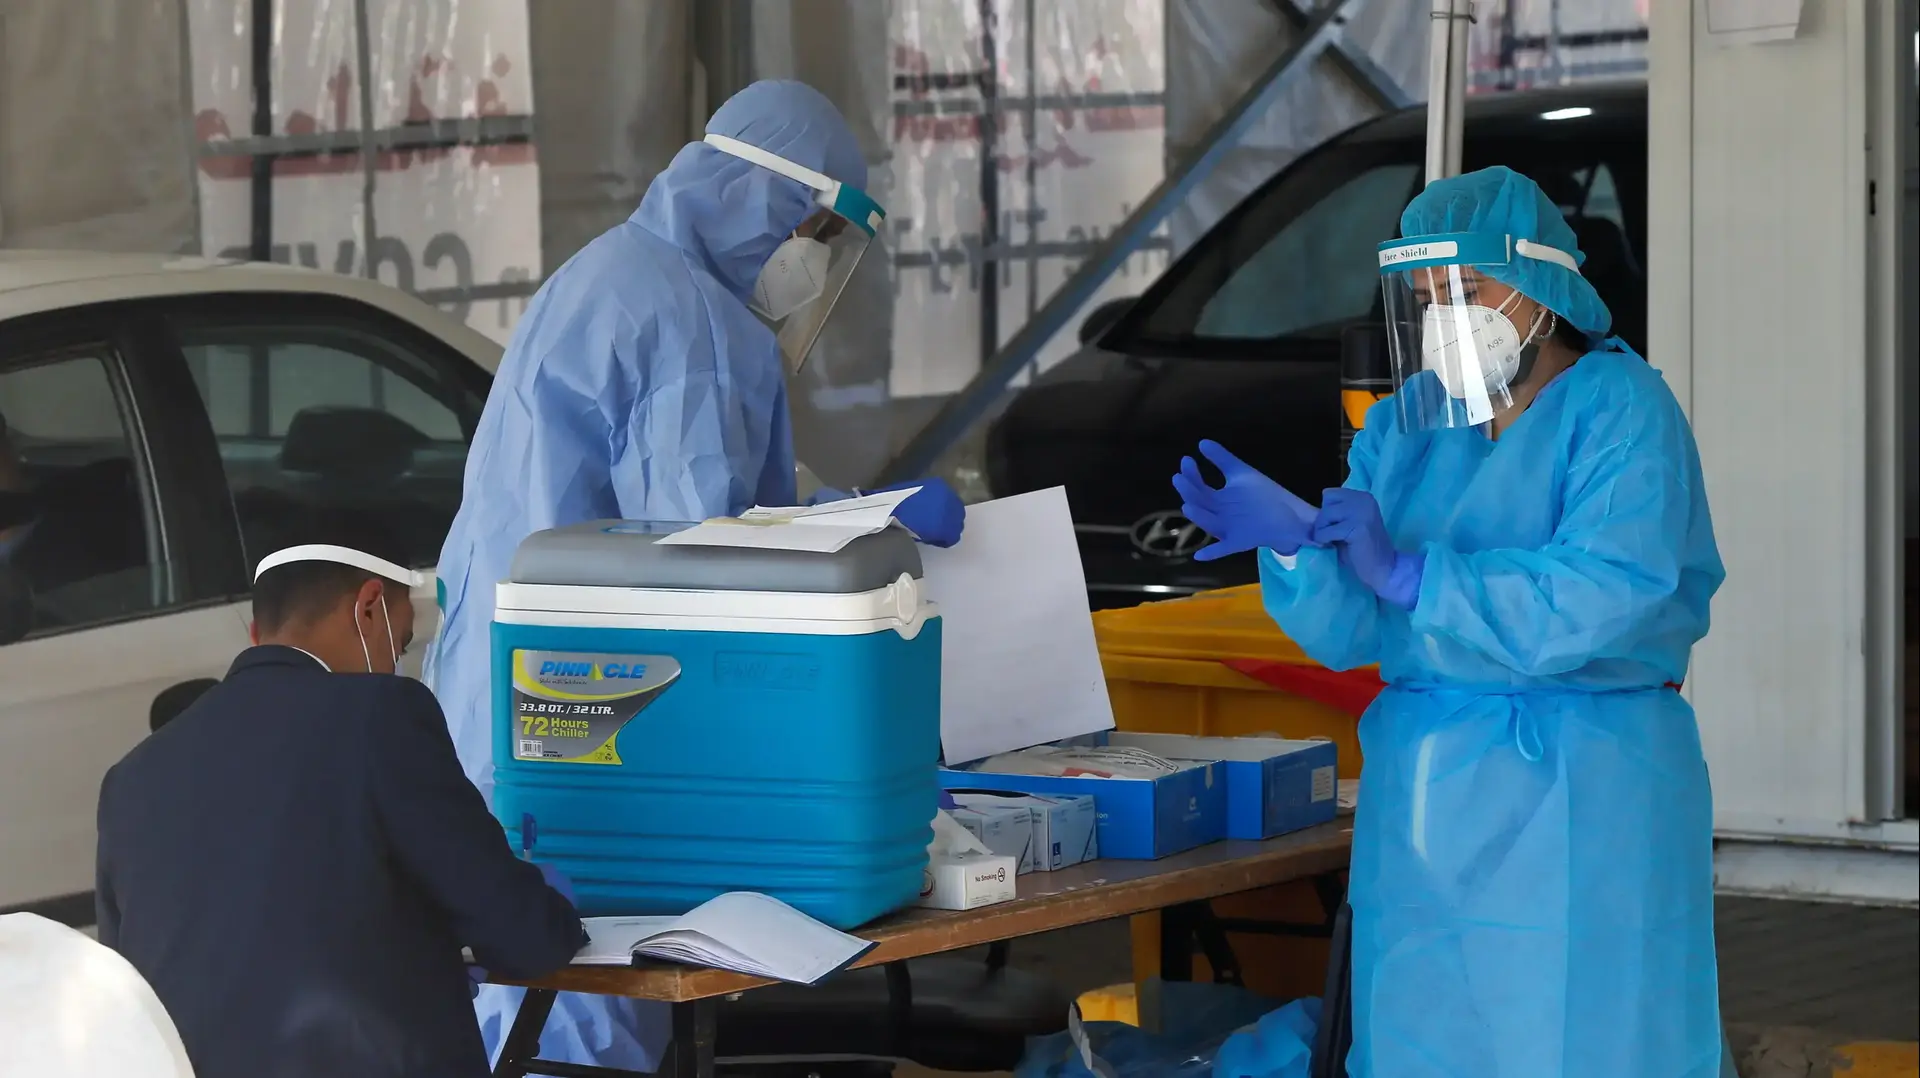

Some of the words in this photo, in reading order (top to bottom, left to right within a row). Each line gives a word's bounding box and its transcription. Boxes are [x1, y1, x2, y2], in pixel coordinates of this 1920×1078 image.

[1400, 247, 1428, 258] Shield
[1487, 336, 1504, 351] N95
[539, 661, 647, 681] PINNACLE
[519, 703, 545, 712] 33.8
[548, 704, 564, 713] QT.
[565, 704, 572, 715] /
[572, 705, 589, 714] 32
[590, 706, 615, 715] LTR.
[520, 716, 549, 736] 72
[551, 717, 589, 729] Hours
[551, 728, 589, 738] Chiller
[981, 873, 997, 882] Smoking
